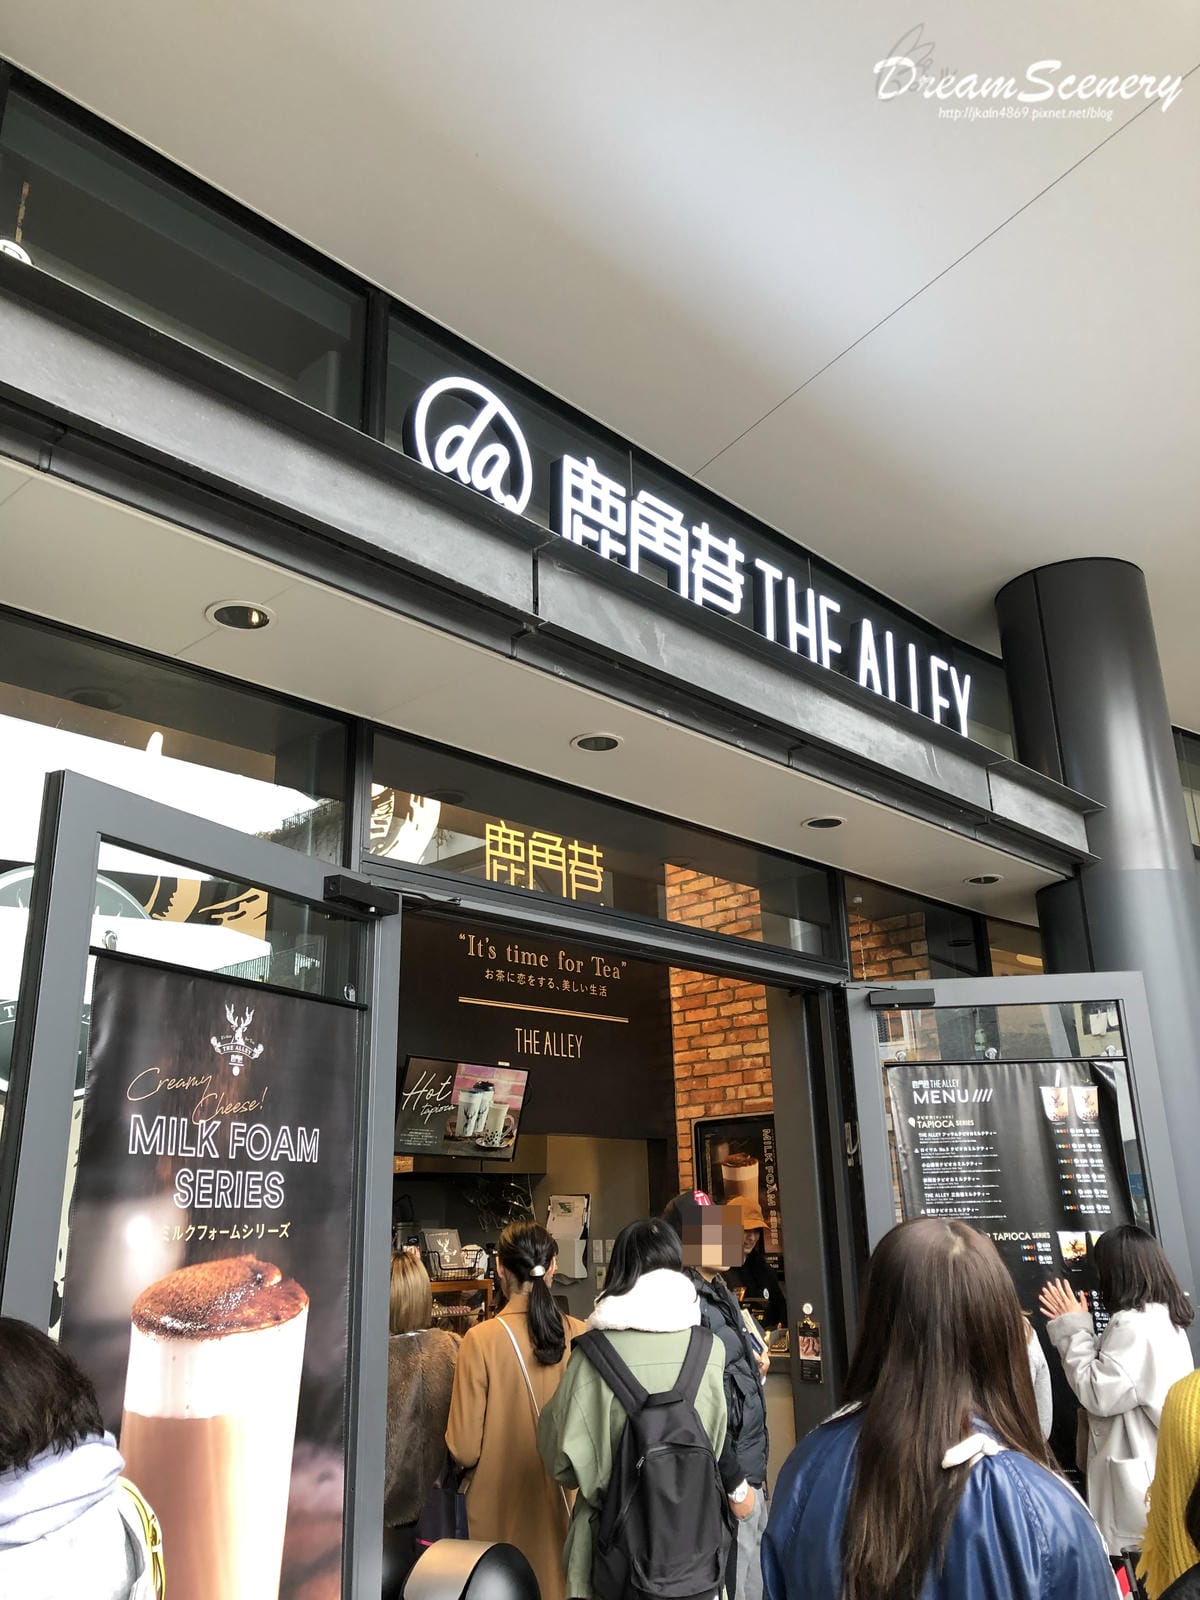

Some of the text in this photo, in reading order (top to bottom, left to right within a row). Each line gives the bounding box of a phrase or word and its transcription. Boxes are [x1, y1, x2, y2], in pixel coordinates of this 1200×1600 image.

[561, 454, 745, 615] 鹿角巷
[755, 558, 841, 669] THE
[486, 820, 604, 900] 鹿角巷
[506, 944, 549, 968] time
[558, 950, 584, 973] for
[485, 968, 608, 998] お茶に恋をする、美しい生活
[515, 1027, 583, 1060] THE ALLEY
[126, 1067, 213, 1102] Creamy
[402, 1070, 453, 1111] Hot
[912, 1089, 969, 1105] MENU
[930, 1080, 941, 1089] THE
[942, 1079, 959, 1088] ALLEY
[191, 1086, 269, 1126] Cheese!
[420, 1102, 457, 1125] tapioca
[128, 1113, 320, 1163] MILK FOAM
[917, 1120, 955, 1129] TAPIOCA
[762, 1128, 773, 1163] MILK
[173, 1167, 285, 1209] SERIES
[161, 1221, 291, 1242] ミルクフォームシリーズ
[992, 1231, 1032, 1241] TAPIOCA
[1032, 1231, 1051, 1239] SERIES
